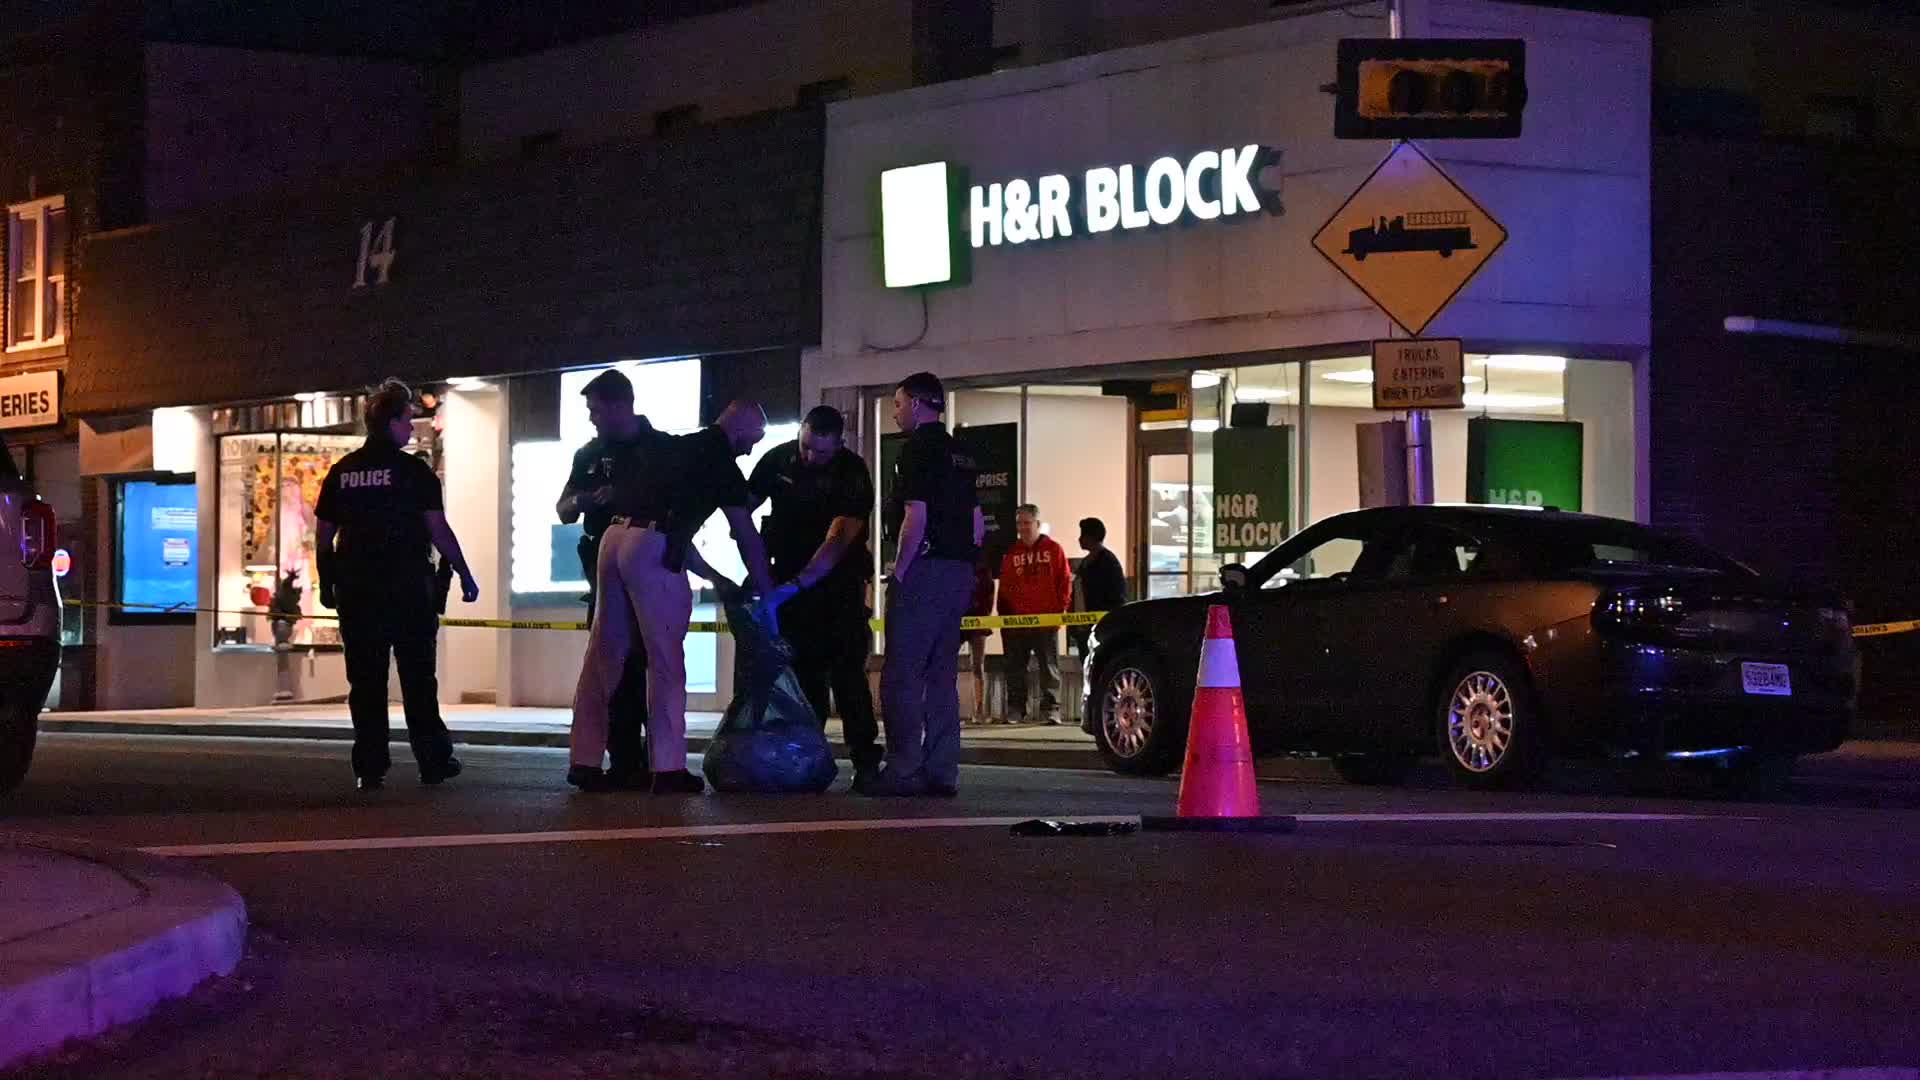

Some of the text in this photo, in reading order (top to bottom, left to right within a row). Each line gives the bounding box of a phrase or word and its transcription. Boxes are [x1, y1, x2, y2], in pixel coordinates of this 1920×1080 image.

[969, 144, 1261, 248] H&R BLOCK
[353, 217, 396, 287] 14
[1397, 347, 1440, 361] TRUCKS
[1392, 366, 1446, 381] ENTERING
[1412, 384, 1456, 401] FLAS
[1, 390, 49, 418] ERIES
[340, 469, 392, 488] POLICE
[1216, 493, 1259, 518] H&R
[1215, 521, 1284, 547] BLOCK
[1012, 550, 1051, 567] DEVLS
[1003, 616, 1040, 626] CAUTION
[1061, 613, 1097, 624] CAUTION
